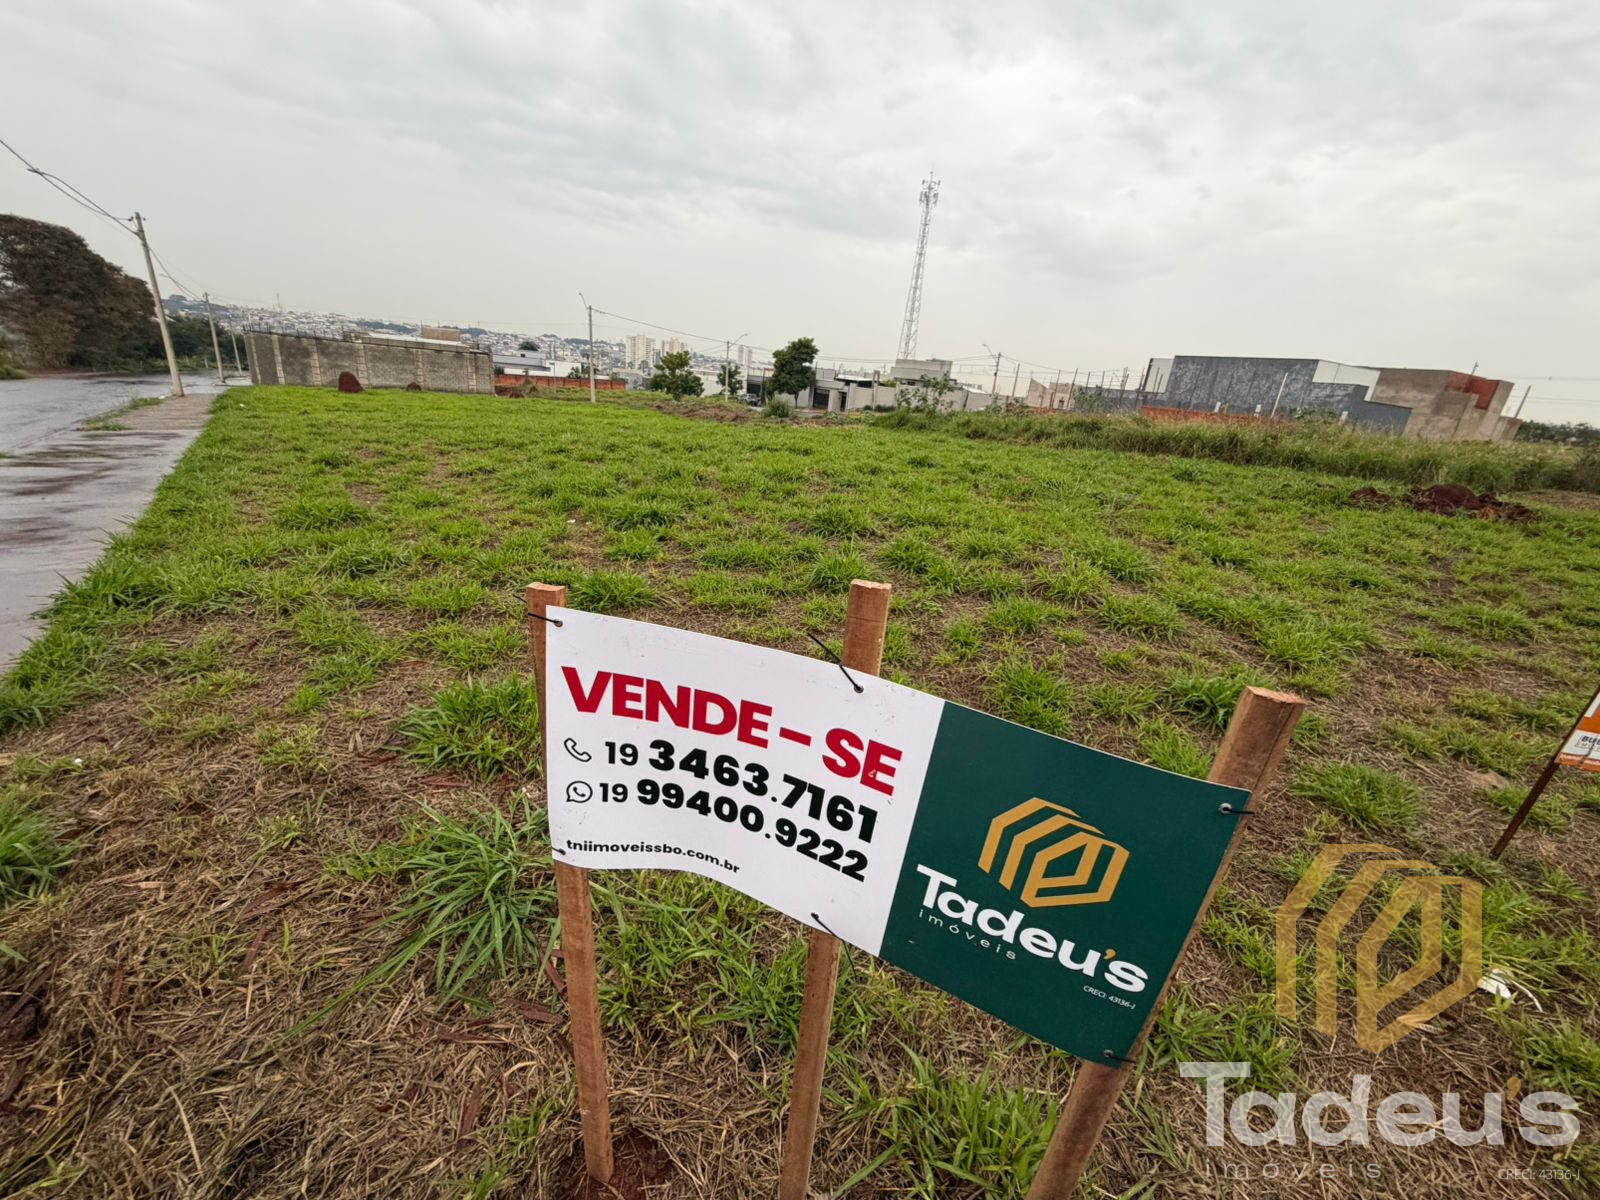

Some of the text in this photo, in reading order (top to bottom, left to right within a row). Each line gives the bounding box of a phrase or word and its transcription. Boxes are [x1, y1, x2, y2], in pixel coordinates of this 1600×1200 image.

[605, 739, 878, 843] 19 3463.7161
[566, 839, 740, 873] tniimoveissbo.com.br
[599, 779, 869, 882] 19 99400.9222
[916, 864, 1149, 992] Tadeu's
[919, 909, 1016, 960] imóveis
[1108, 995, 1136, 1010] 43136-J
